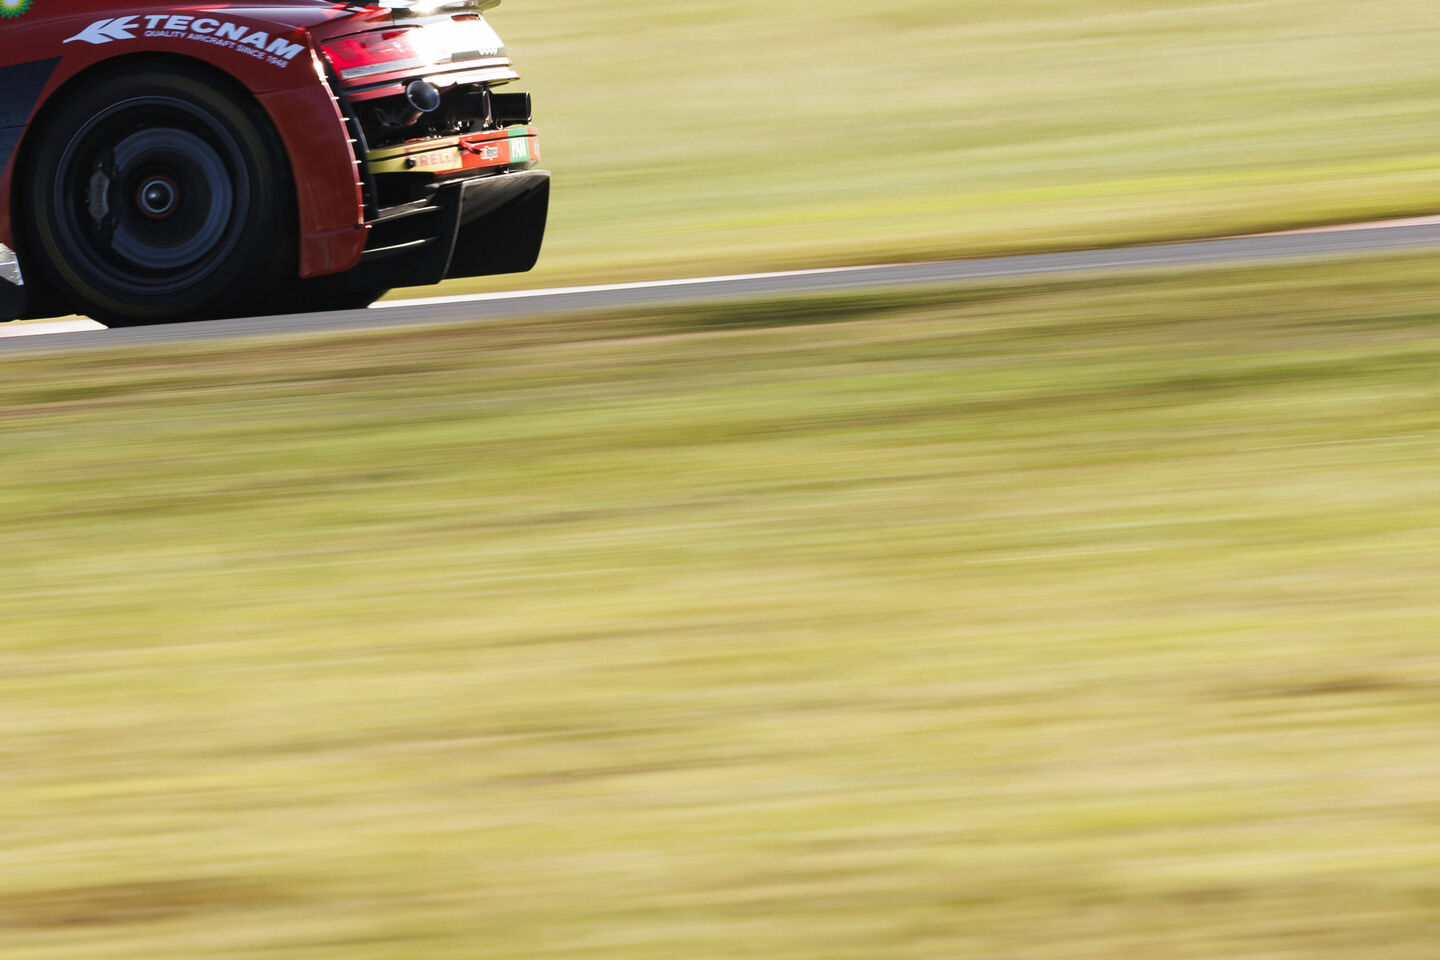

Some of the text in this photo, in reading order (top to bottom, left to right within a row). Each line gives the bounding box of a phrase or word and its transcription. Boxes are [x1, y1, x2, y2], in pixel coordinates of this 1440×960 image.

[143, 15, 306, 60] TECNAM
[144, 30, 186, 38] QUALITY
[186, 33, 236, 49] AIRCRAFT
[235, 44, 265, 60] SINCE
